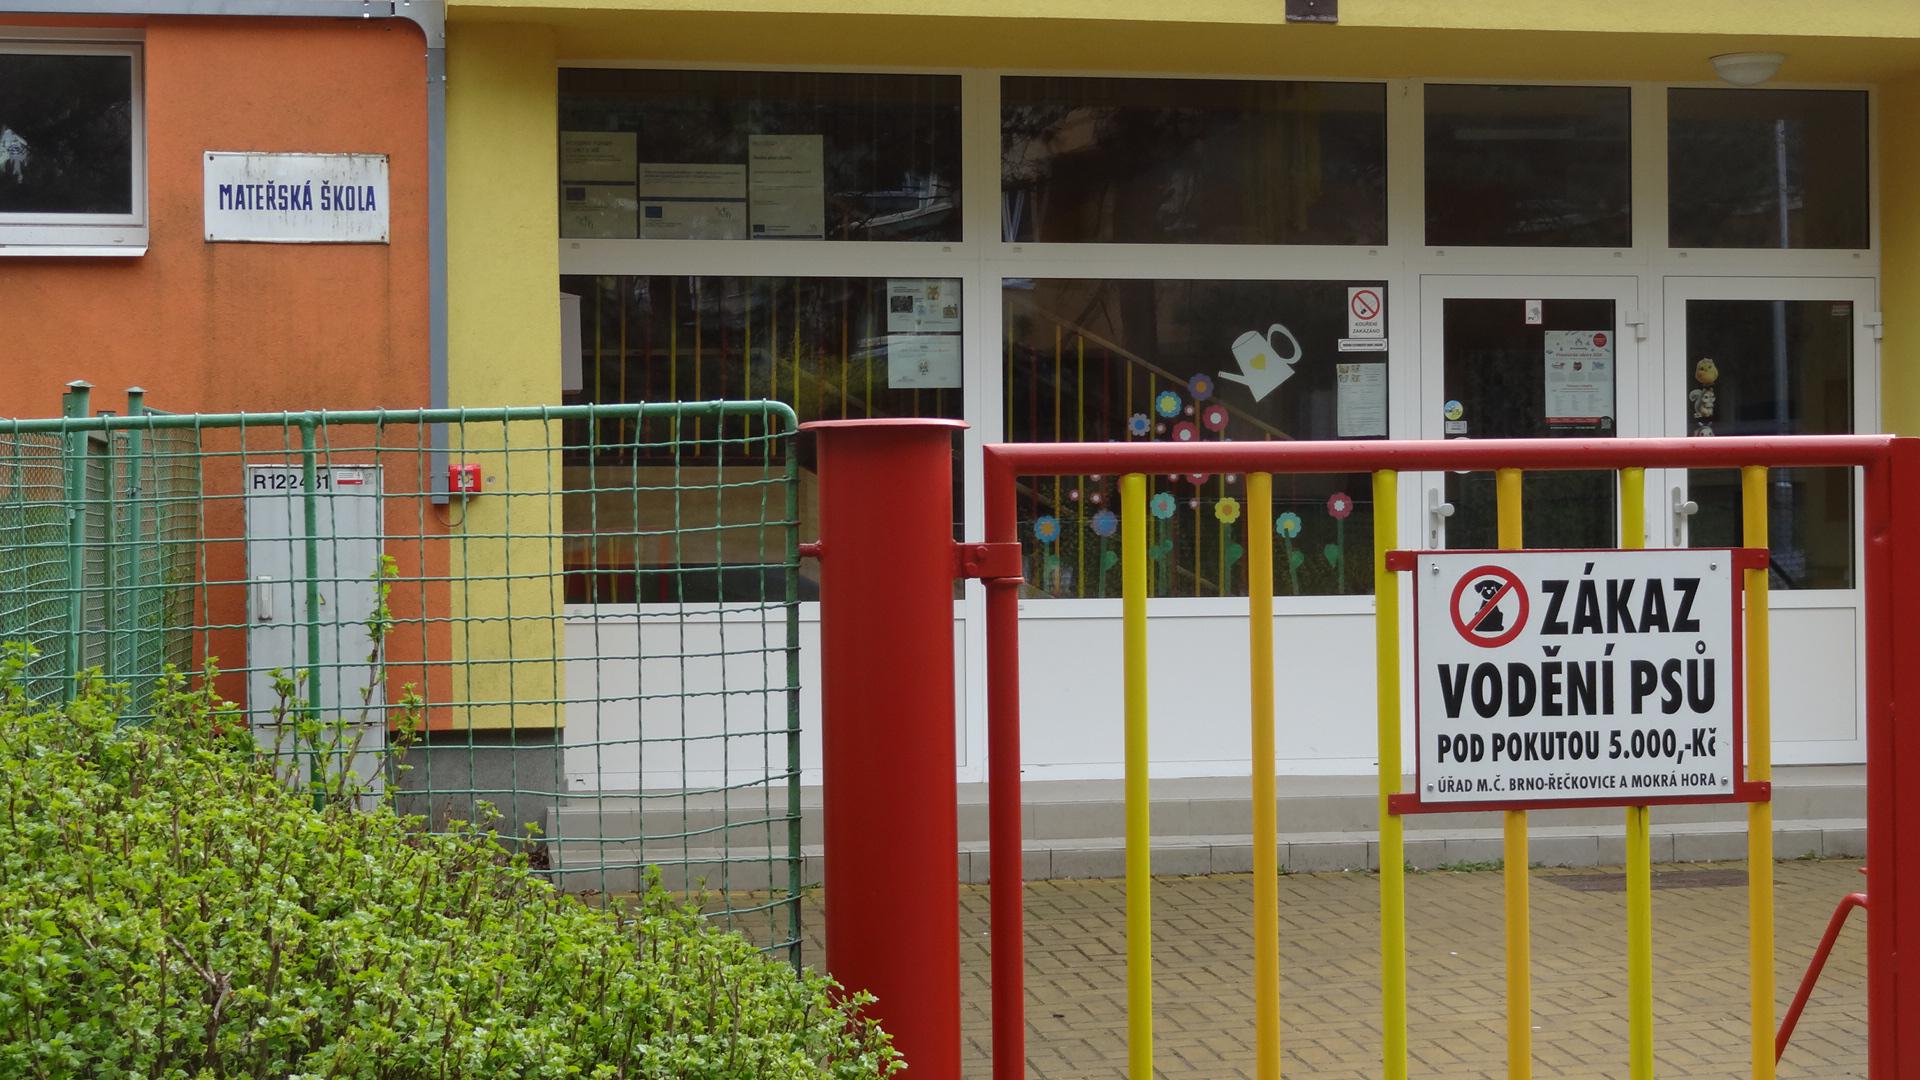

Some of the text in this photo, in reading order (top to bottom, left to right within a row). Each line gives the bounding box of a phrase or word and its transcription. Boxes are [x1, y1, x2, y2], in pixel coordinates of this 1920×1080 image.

[219, 180, 376, 211] MATEŘSKÁ ŠKOLA
[1539, 562, 1701, 635] ZÁKAZ
[1437, 640, 1716, 719] VODĚNÍ PSŮ
[1437, 733, 1485, 763] POD
[1491, 730, 1600, 762] POKUTOU
[1438, 770, 1717, 793] ÚŘAD M.Č. BRNO-ŘEČKOVICE A MOKRÁ HORA
